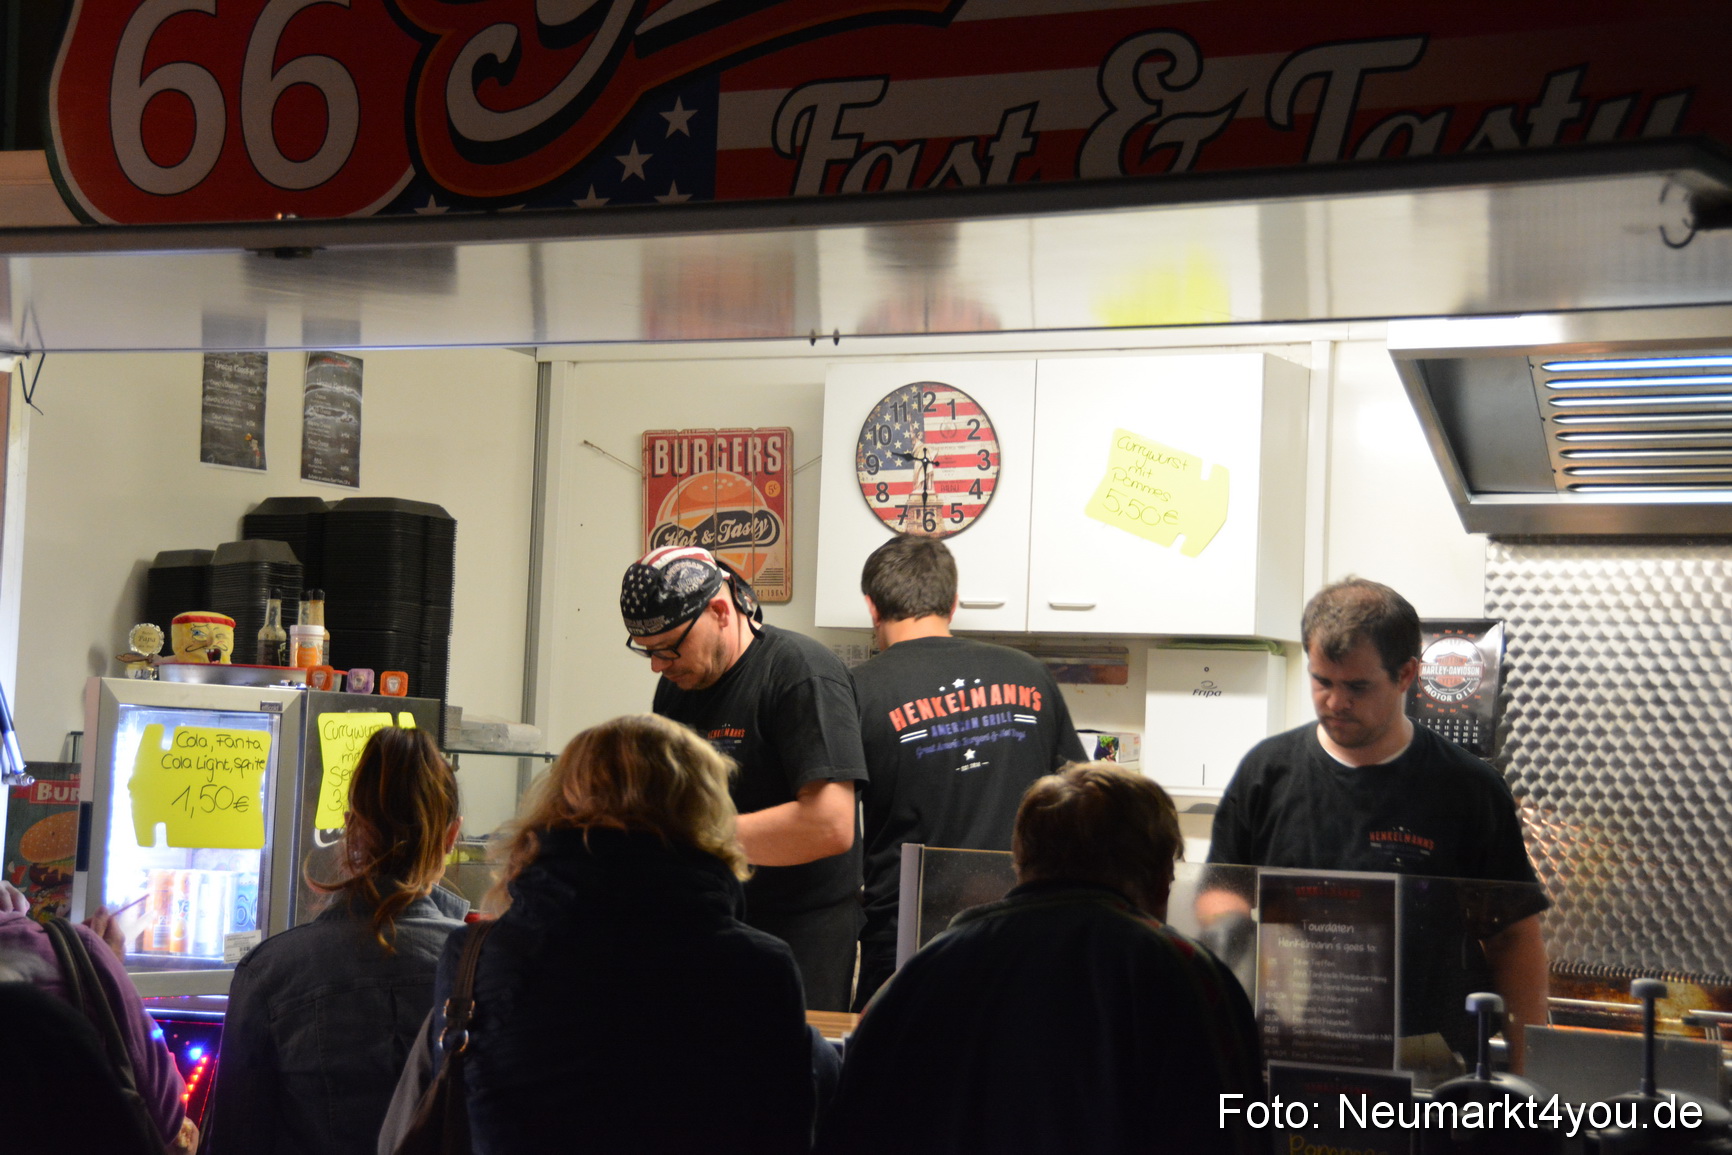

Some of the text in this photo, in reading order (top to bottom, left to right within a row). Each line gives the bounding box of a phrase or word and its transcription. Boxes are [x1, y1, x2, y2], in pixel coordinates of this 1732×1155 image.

[109, 0, 361, 195] 66
[771, 74, 1041, 196] Fast
[1076, 28, 1249, 180] &
[890, 402, 908, 423] 11
[912, 391, 937, 413] 12
[946, 399, 956, 420] 1
[868, 424, 892, 446] 10
[966, 419, 981, 441] 2
[653, 436, 783, 476] BURGERS
[977, 449, 991, 471] 3
[1117, 435, 1188, 470] Currywurst
[865, 454, 880, 476] 9
[875, 481, 890, 503] 8
[968, 478, 983, 500] 4
[895, 504, 909, 526] 7
[950, 502, 964, 524] 5
[1103, 488, 1179, 526] 5,50€
[701, 533, 716, 545] &
[719, 516, 769, 543] Tasty
[922, 511, 937, 532] 6
[1424, 684, 1476, 702] MOTOR OIL
[888, 683, 1042, 732] HENKELMANN'S
[176, 730, 263, 753] Cola, Fanta
[323, 720, 384, 752] Currywurs
[161, 753, 192, 770] Cola
[171, 783, 250, 819] 1,50€
